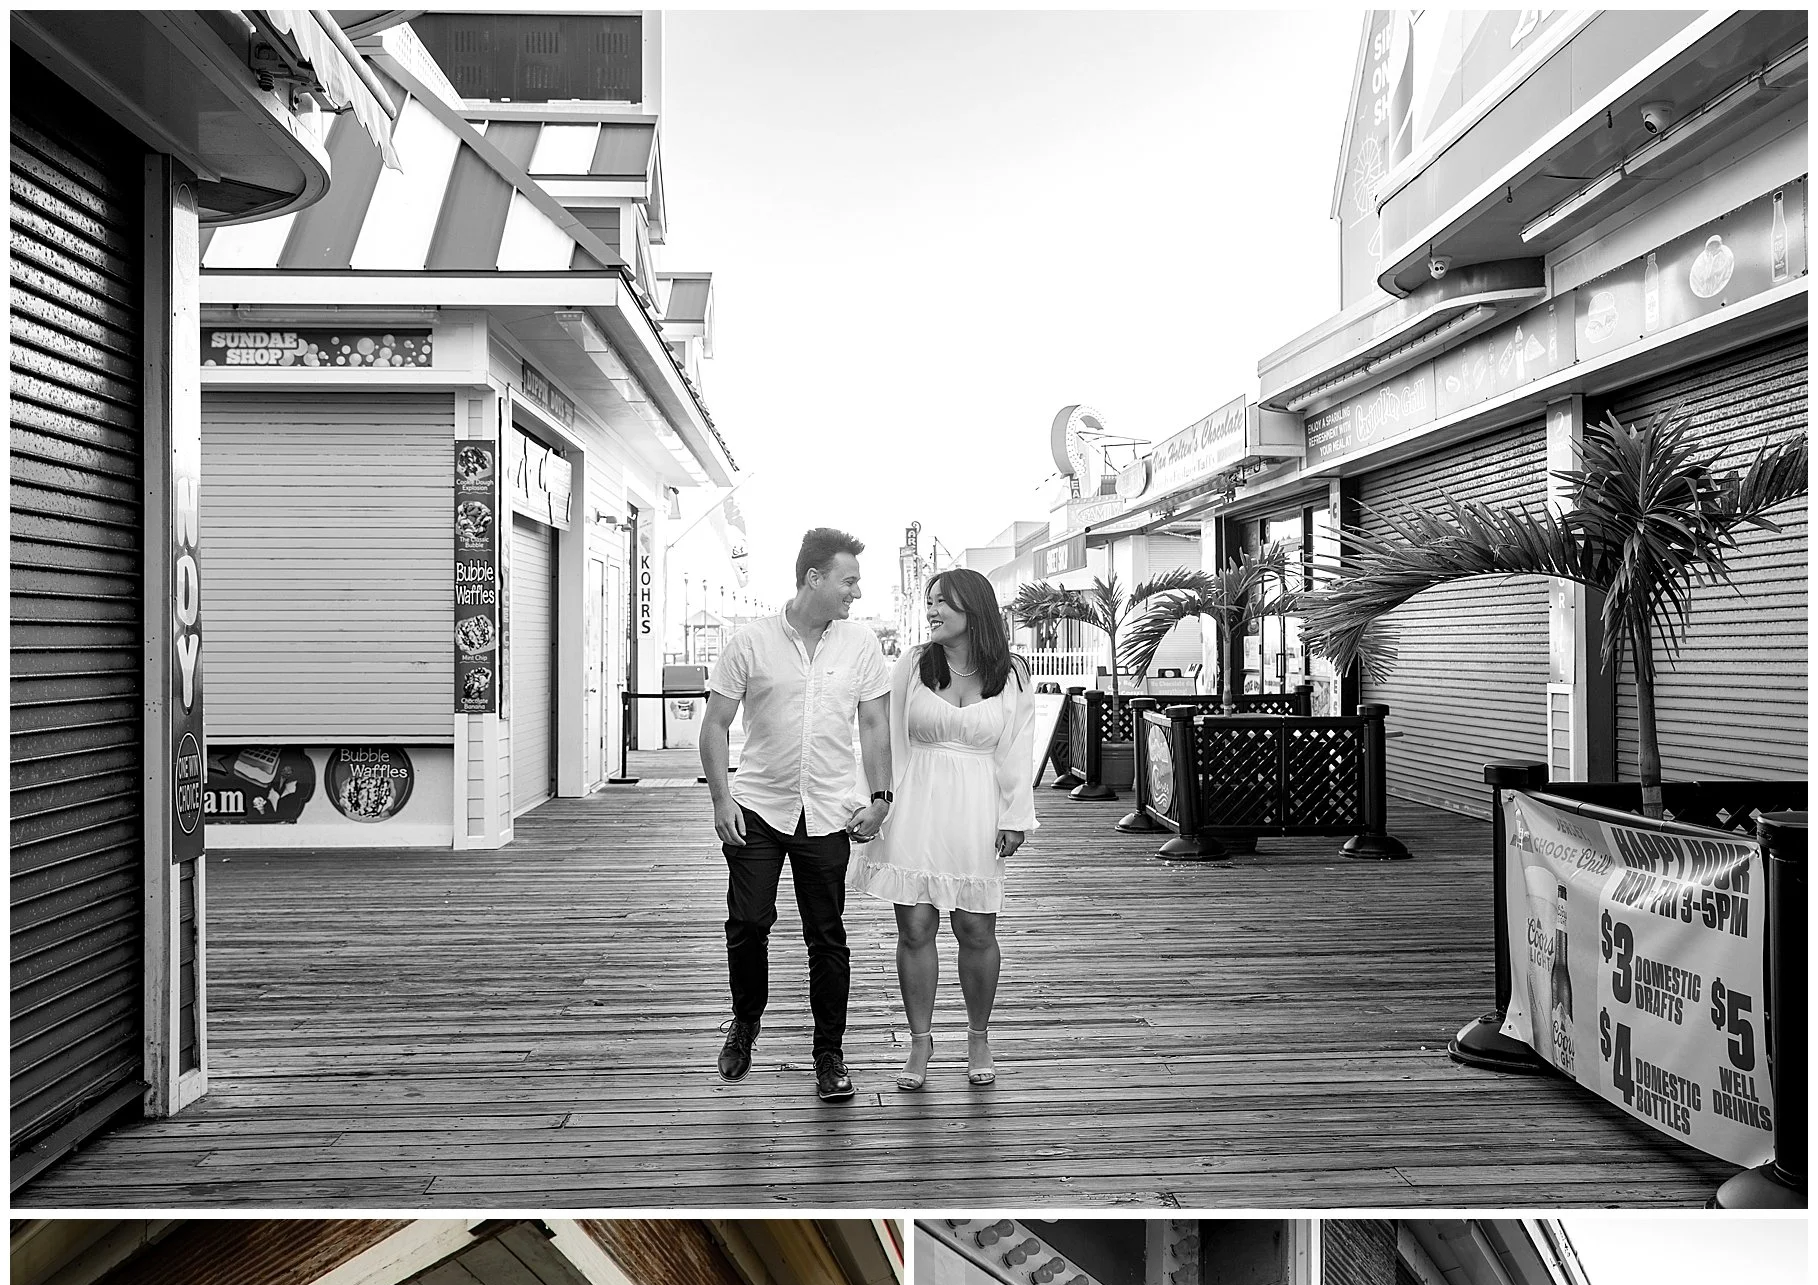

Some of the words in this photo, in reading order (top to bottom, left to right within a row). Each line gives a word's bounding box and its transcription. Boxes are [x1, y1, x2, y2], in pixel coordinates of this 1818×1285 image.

[211, 332, 298, 349] SUNDAE
[226, 348, 283, 365] SHOP
[1326, 406, 1351, 426] SPARKLING
[1401, 378, 1427, 416] Grill
[1201, 408, 1244, 450] Chocolate
[1320, 442, 1333, 457] YOUR
[1333, 438, 1345, 452] MEAL
[456, 560, 494, 583] Bubble
[455, 584, 495, 605] Waffles
[641, 555, 651, 634] KOHRS
[179, 757, 188, 779] ONE
[188, 754, 199, 776] WIN
[340, 749, 390, 763] Bubble
[350, 764, 408, 779] Waffles
[179, 782, 200, 813] CHOICE
[1533, 837, 1578, 864] CHOOSE
[1577, 848, 1613, 876] Chill
[1610, 827, 1685, 880] HAPPY
[1683, 838, 1750, 895] HOUR
[1681, 885, 1749, 938] 3-5PM
[1527, 918, 1555, 956] Coors
[1601, 908, 1634, 1004] $3
[1529, 947, 1551, 972] LIGHT
[1634, 955, 1702, 1003] DOMESTIC
[1634, 983, 1684, 1026] DRAFTS
[1711, 977, 1756, 1072] $5
[1600, 1006, 1635, 1106] $4
[1635, 1057, 1702, 1112] DOMESTIC
[1718, 1066, 1760, 1103] WELL
[1636, 1084, 1691, 1135] BOTTLES
[1713, 1088, 1773, 1132] DRINKS
